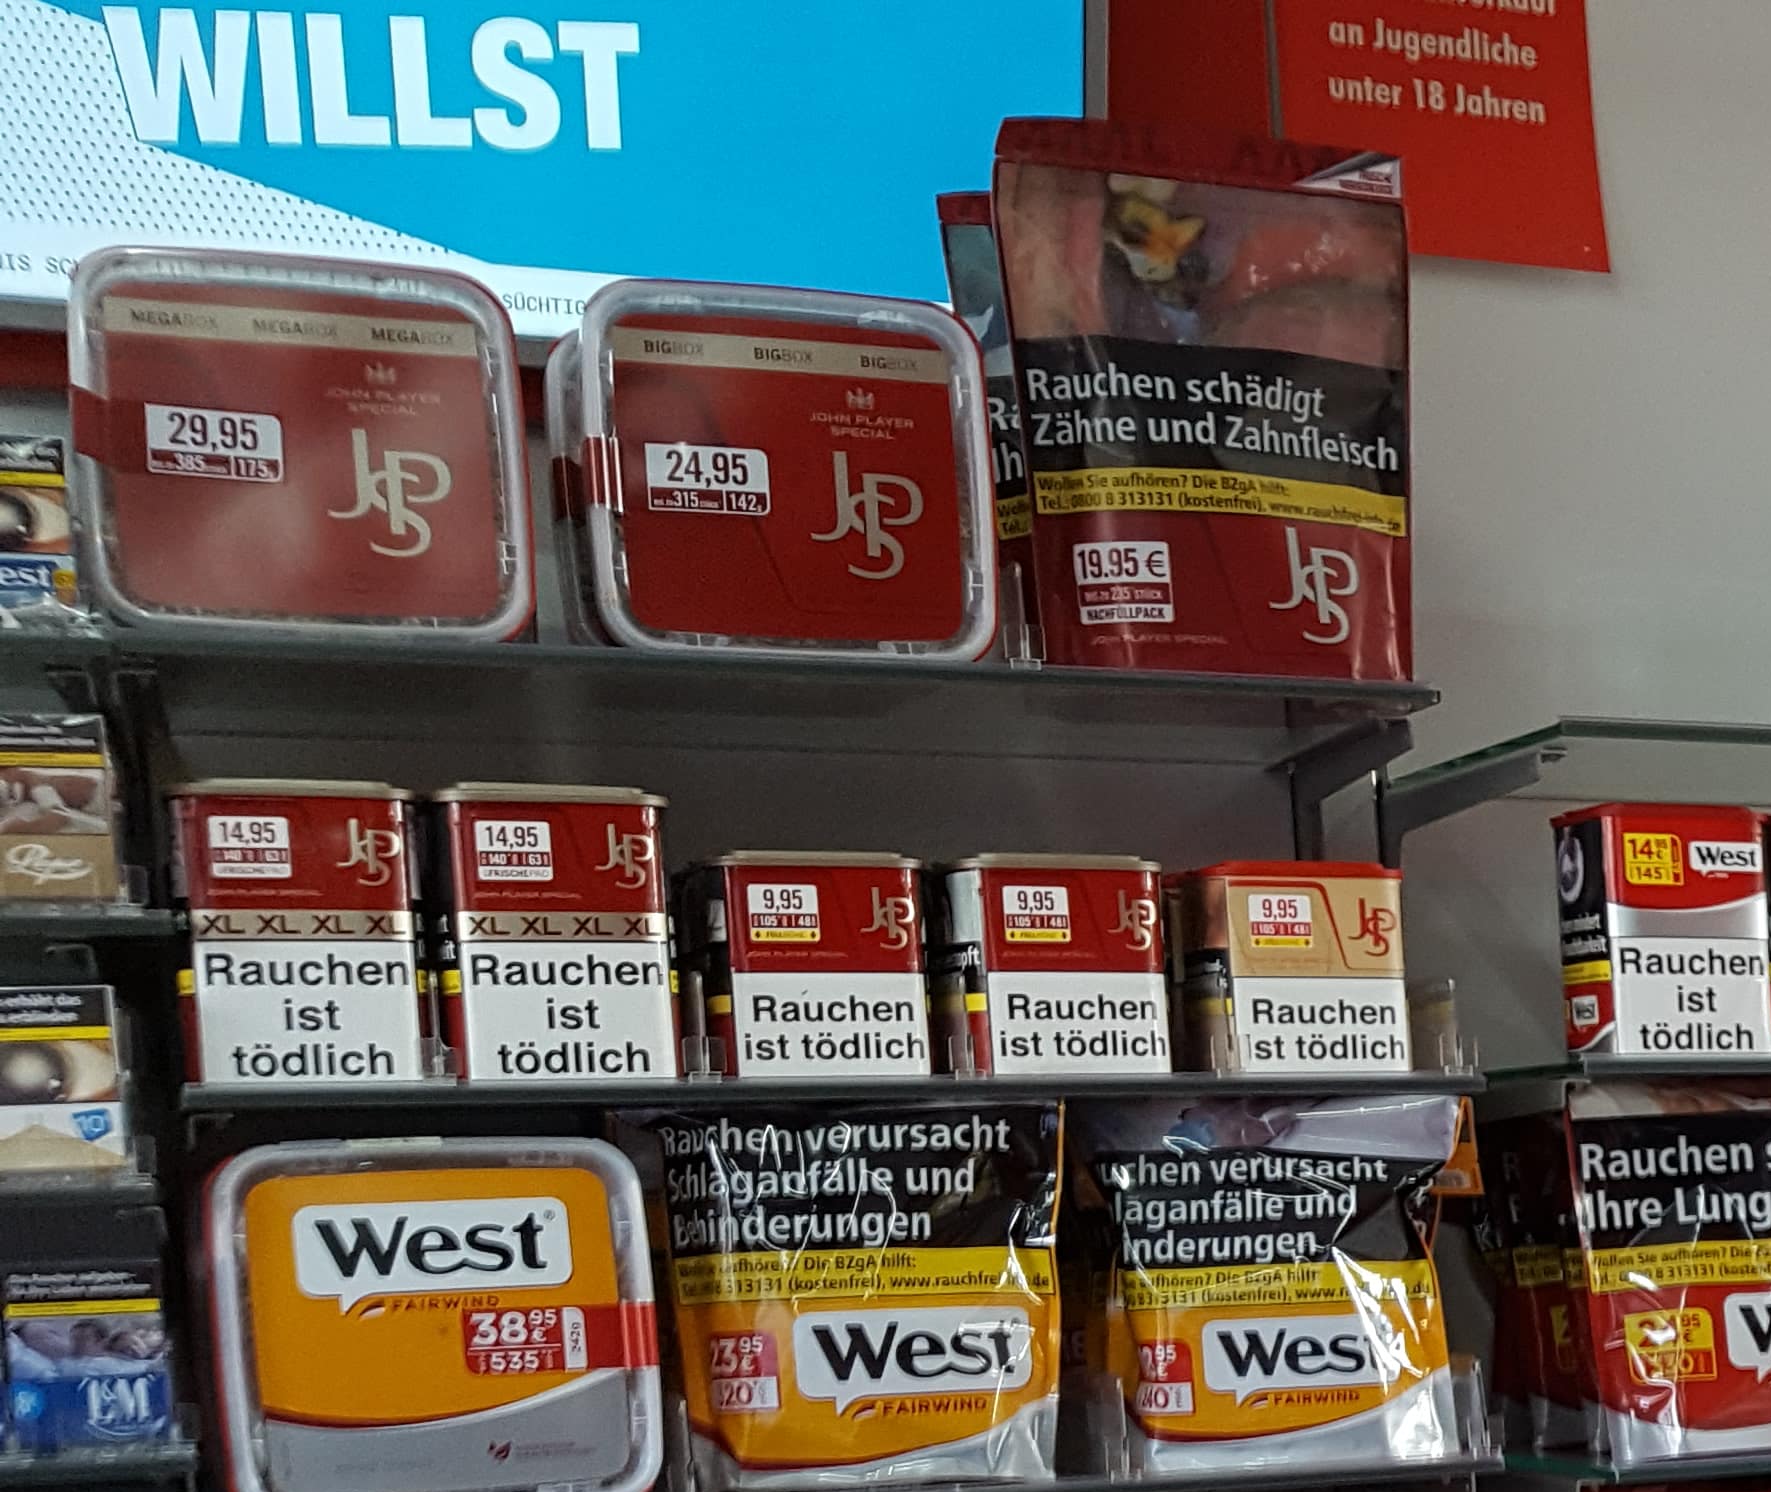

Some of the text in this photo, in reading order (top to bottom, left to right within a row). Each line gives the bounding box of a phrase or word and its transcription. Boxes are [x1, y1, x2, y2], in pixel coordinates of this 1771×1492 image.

[1328, 18, 1537, 67] an Jugendliche
[103, 5, 641, 151] WILLST
[1328, 76, 1546, 125] unter 18 Jahren
[1027, 363, 1326, 419] Rauchen schädigt
[168, 412, 258, 452] 29,95
[1030, 410, 1400, 472] Zähne und Zahnfleisch
[666, 449, 748, 487] 24,95
[1076, 548, 1140, 580] 19.95
[218, 821, 277, 845] 14,95
[484, 826, 539, 849] 14,95
[1696, 847, 1757, 867] West
[762, 887, 803, 914] 9,95
[1016, 887, 1055, 912] 9,95
[1261, 896, 1298, 920] 9,95
[200, 914, 355, 935] XL XL XL
[205, 953, 410, 988] Rauchen
[471, 954, 664, 986] Rauchen
[1620, 948, 1764, 976] Rauchen
[546, 998, 600, 1030] ist
[752, 996, 914, 1023] Rauchen
[1008, 995, 1158, 1021] Rauchen
[1252, 1000, 1397, 1025] Rauchen
[1677, 986, 1716, 1012] ist
[284, 1000, 341, 1031] ist
[745, 1031, 924, 1062] ist tödlich
[1000, 1029, 1166, 1058] ist tödlich
[1291, 1034, 1405, 1061] tödlich
[1640, 1024, 1754, 1050] tödlich
[232, 1043, 396, 1078] tödlich
[499, 1041, 651, 1073] tödlich
[661, 1116, 1010, 1157] Rauchen verursacht
[1209, 1154, 1388, 1184] verursacht
[1579, 1136, 1754, 1182] Rauchen
[667, 1156, 975, 1203] Schlaganfälle und
[1293, 1186, 1357, 1216] und
[1582, 1188, 1662, 1230] Ihre
[314, 1212, 548, 1278] West
[674, 1210, 932, 1250] Behinderungen
[391, 1296, 500, 1313] FAIRWIND
